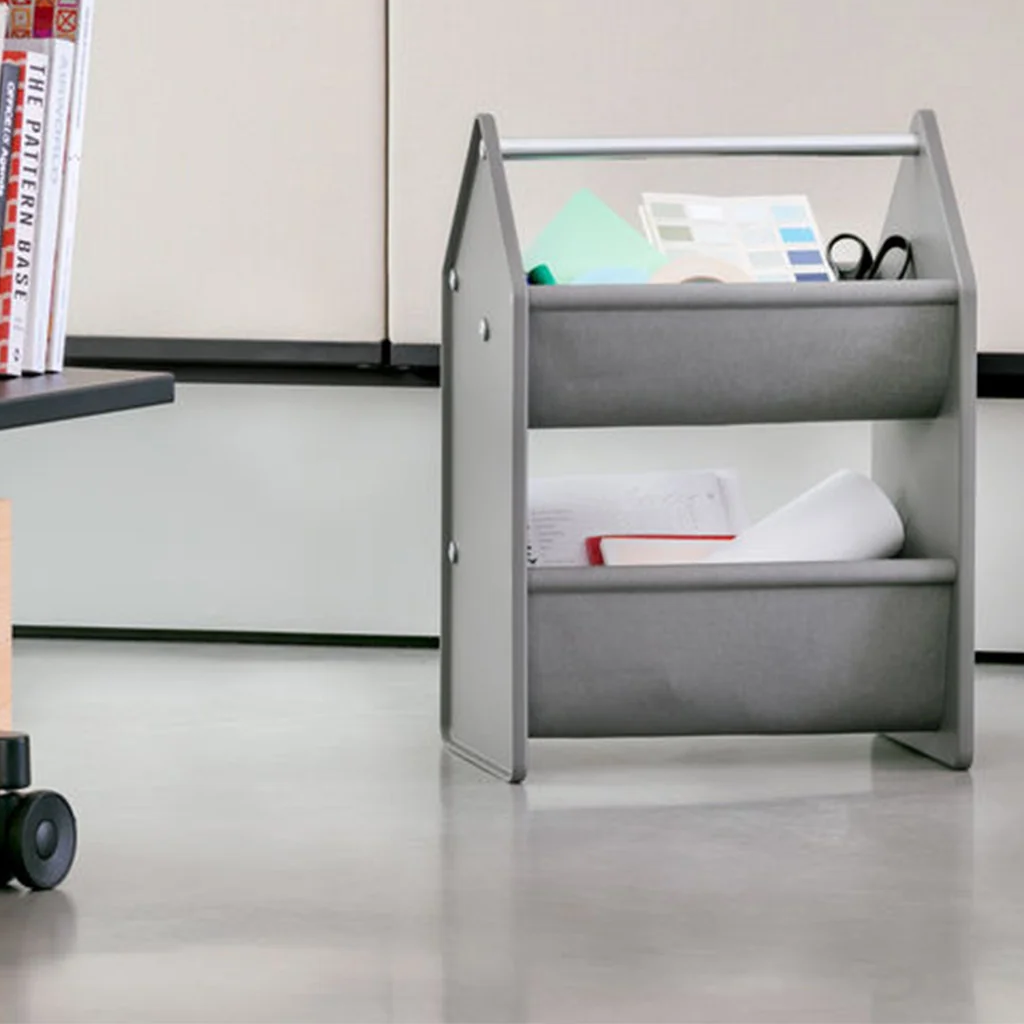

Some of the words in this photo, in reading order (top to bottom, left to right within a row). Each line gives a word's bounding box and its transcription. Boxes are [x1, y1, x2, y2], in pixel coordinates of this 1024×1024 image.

[27, 64, 46, 108] THE
[19, 118, 42, 225] PATTERN
[14, 239, 31, 300] BASE
